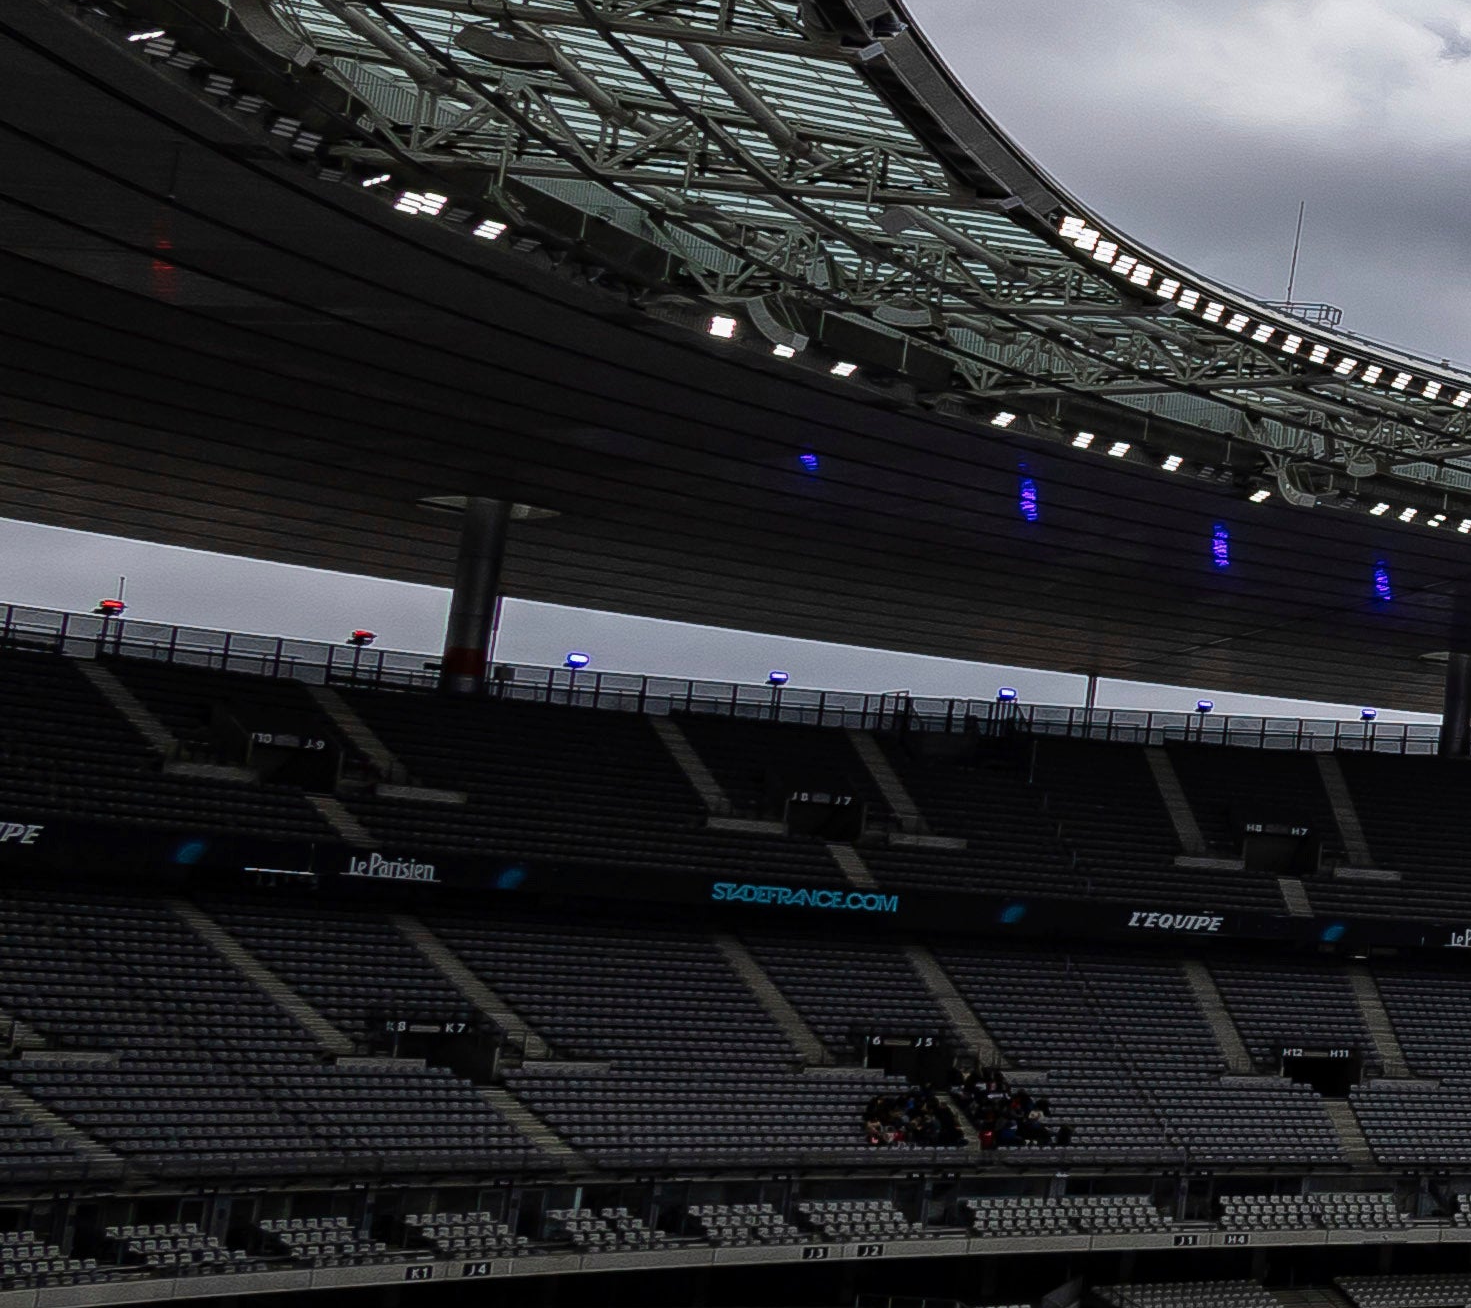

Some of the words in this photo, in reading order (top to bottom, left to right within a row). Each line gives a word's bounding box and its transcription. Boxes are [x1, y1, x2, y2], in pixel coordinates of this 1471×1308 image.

[349, 856, 368, 876] Le
[367, 852, 435, 881] Parisien
[711, 882, 899, 913] STADEFRANCE.COM
[1450, 932, 1464, 947] Le
[386, 1021, 406, 1032] K8
[445, 1023, 466, 1034] K7
